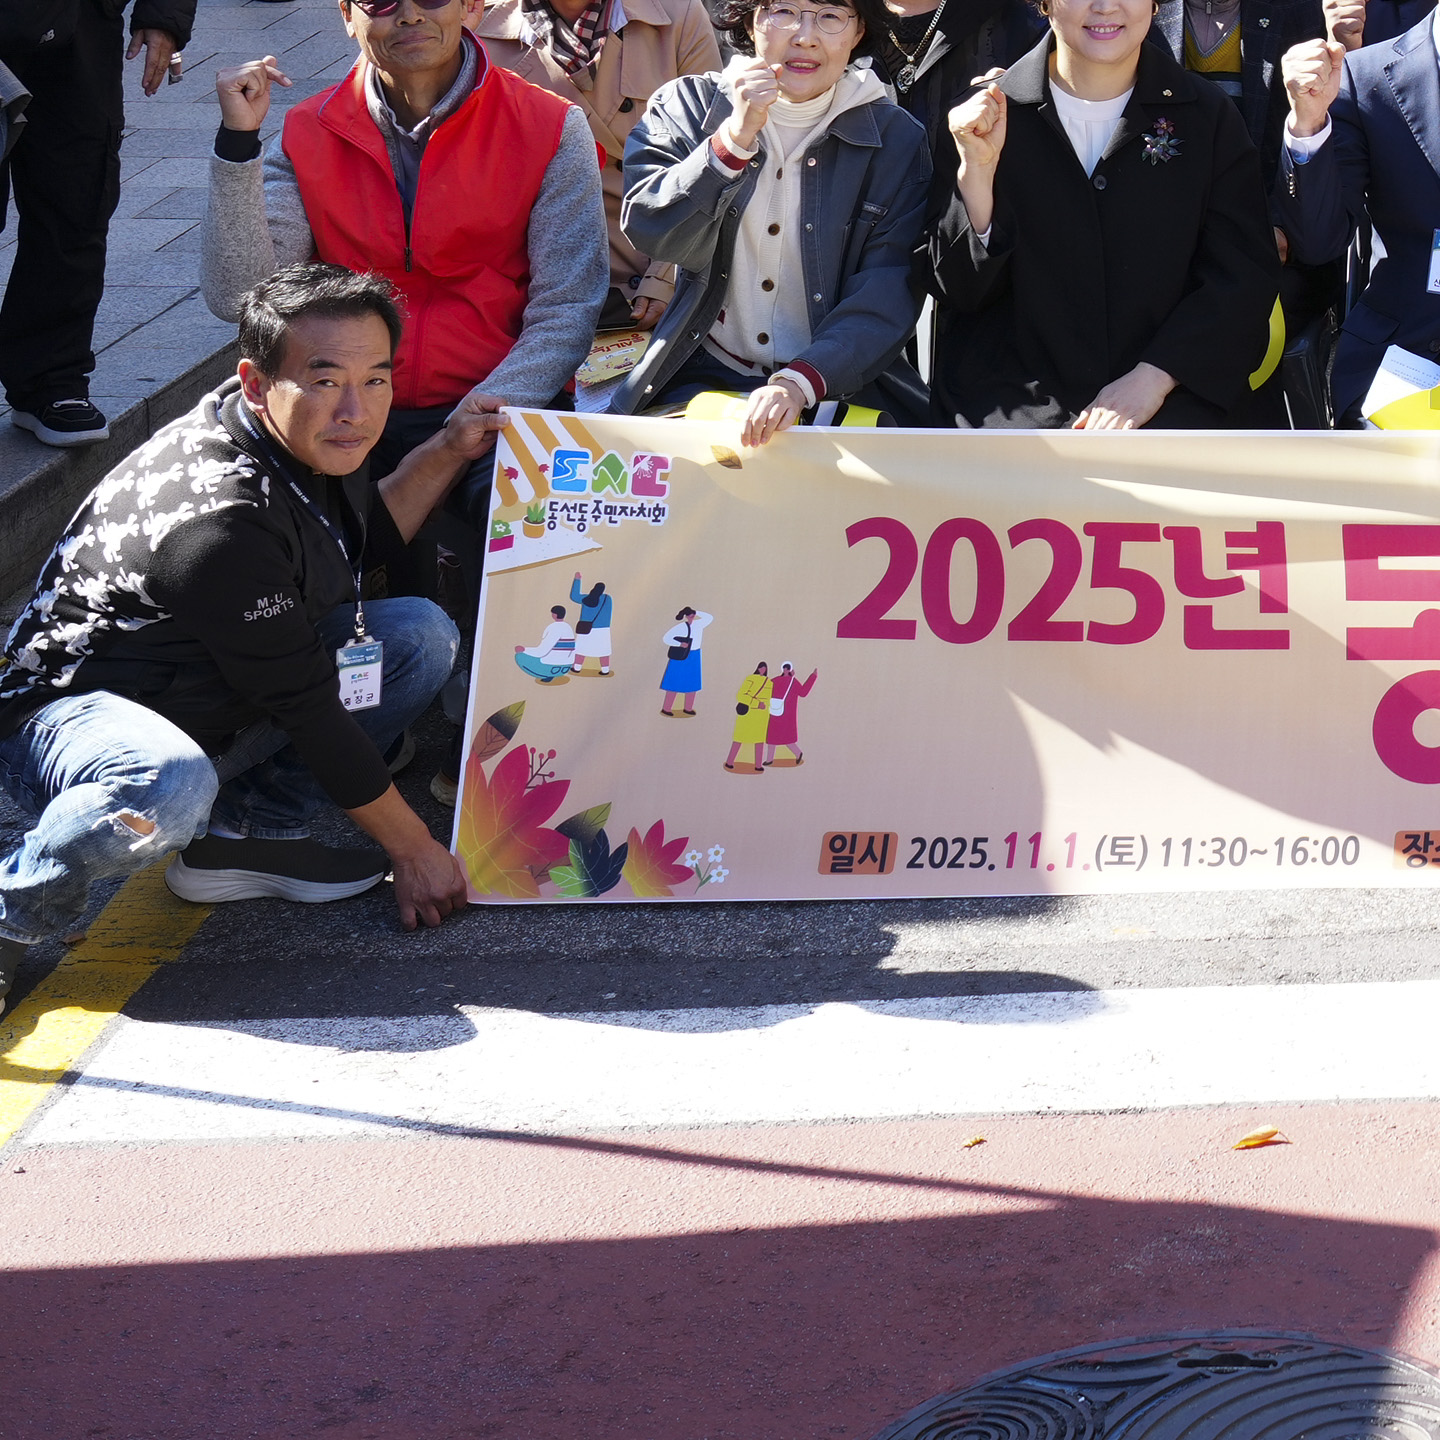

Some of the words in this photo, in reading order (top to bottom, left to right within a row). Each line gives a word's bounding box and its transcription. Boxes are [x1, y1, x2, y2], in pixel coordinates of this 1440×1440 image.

[548, 499, 667, 533] 동선동주민자치회
[836, 516, 1290, 650] 2025년
[244, 597, 294, 622] SPORTS
[828, 836, 893, 872] 일시
[1160, 833, 1361, 869] 11:30~16:00
